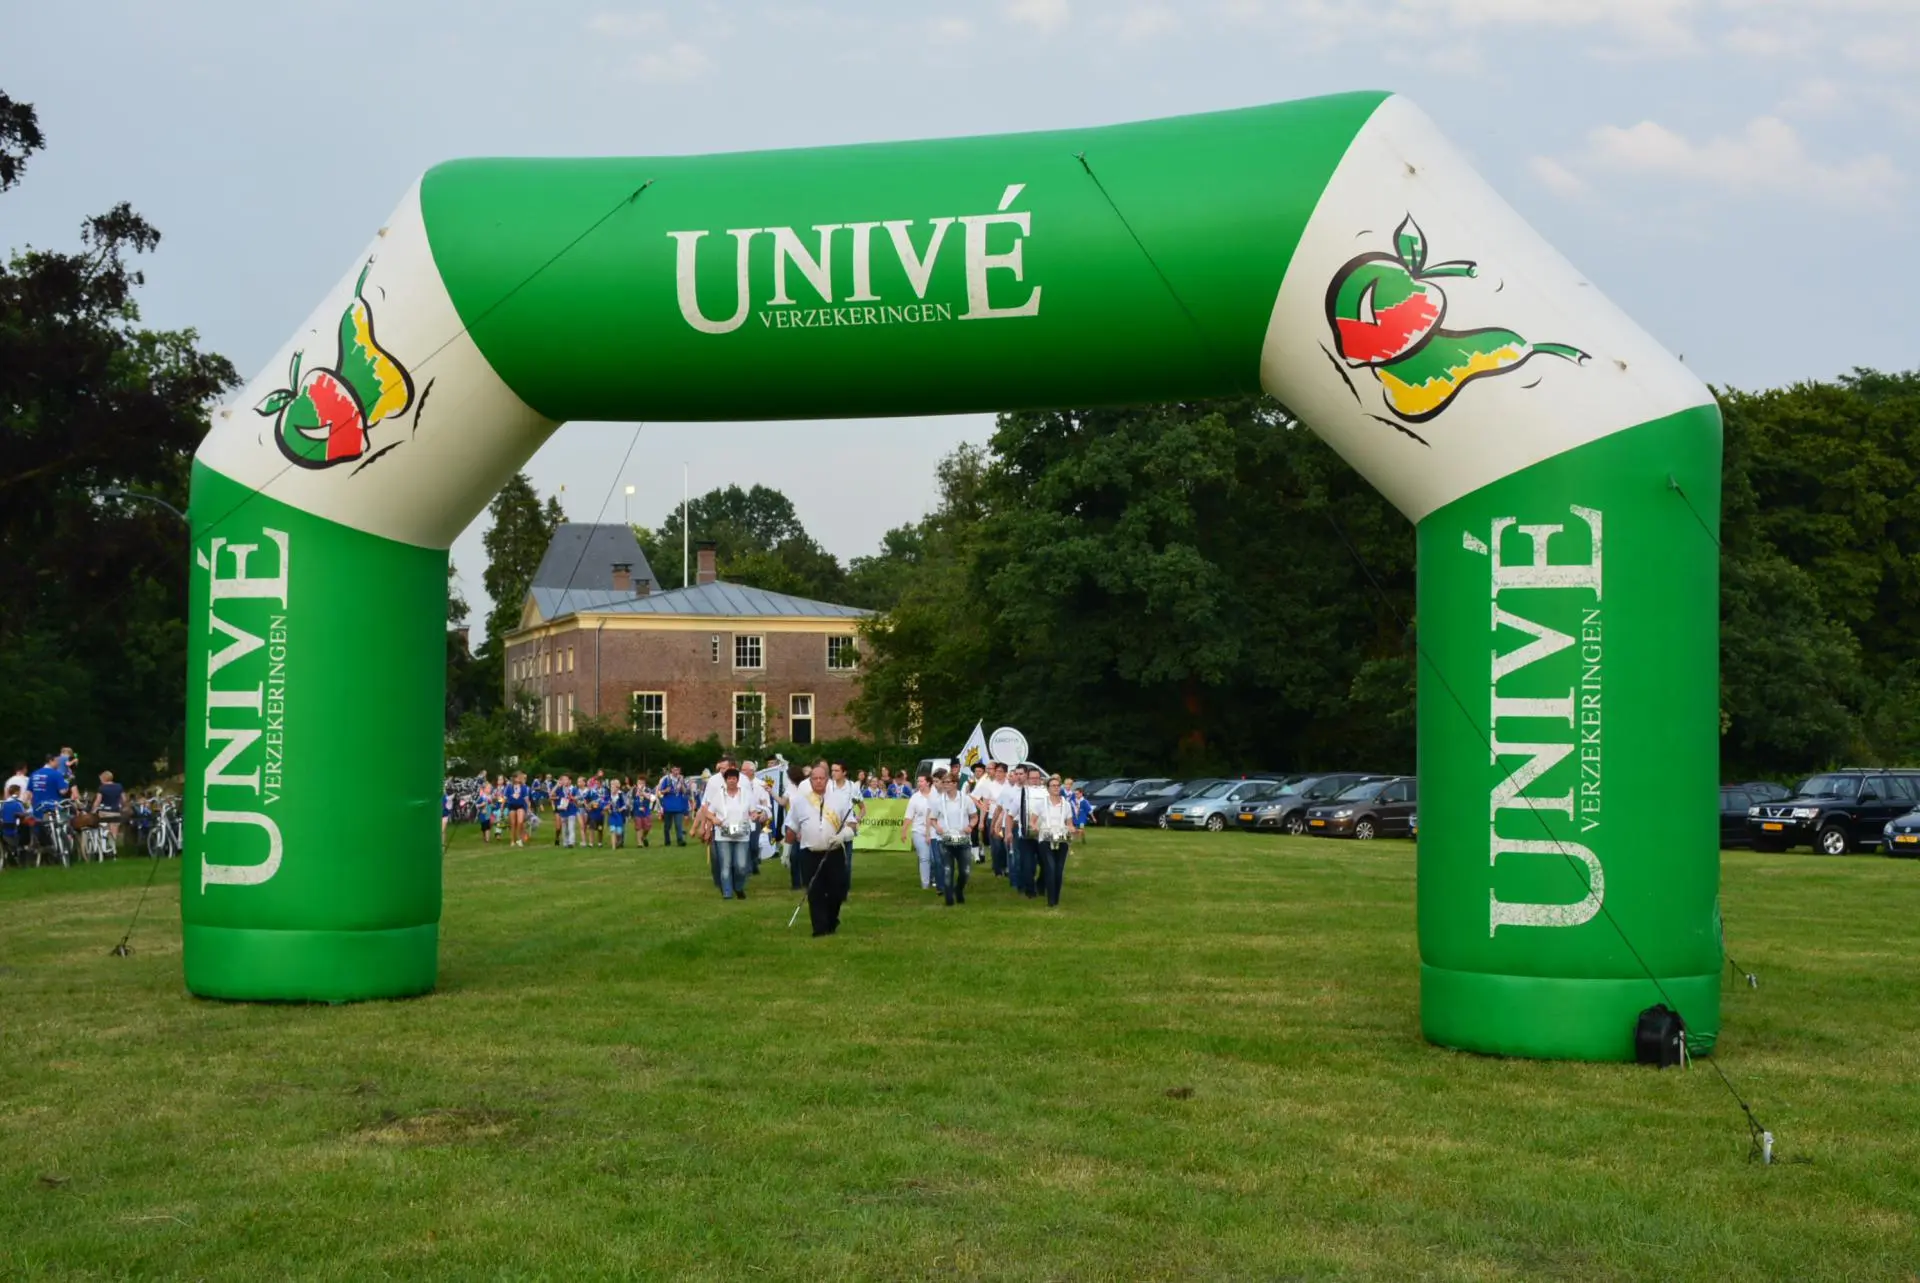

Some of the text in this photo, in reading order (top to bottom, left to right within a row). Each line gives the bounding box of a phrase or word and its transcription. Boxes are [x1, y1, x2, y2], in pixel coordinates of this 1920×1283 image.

[667, 184, 1042, 333] UNIVÉ
[759, 302, 951, 329] VERZEKERINGEN
[196, 526, 290, 895] UNIVÉ
[263, 615, 288, 805] VERZEKERINGEN
[1463, 504, 1605, 938] UNIVÉ
[1581, 608, 1602, 834] VERZEKERINGEN
